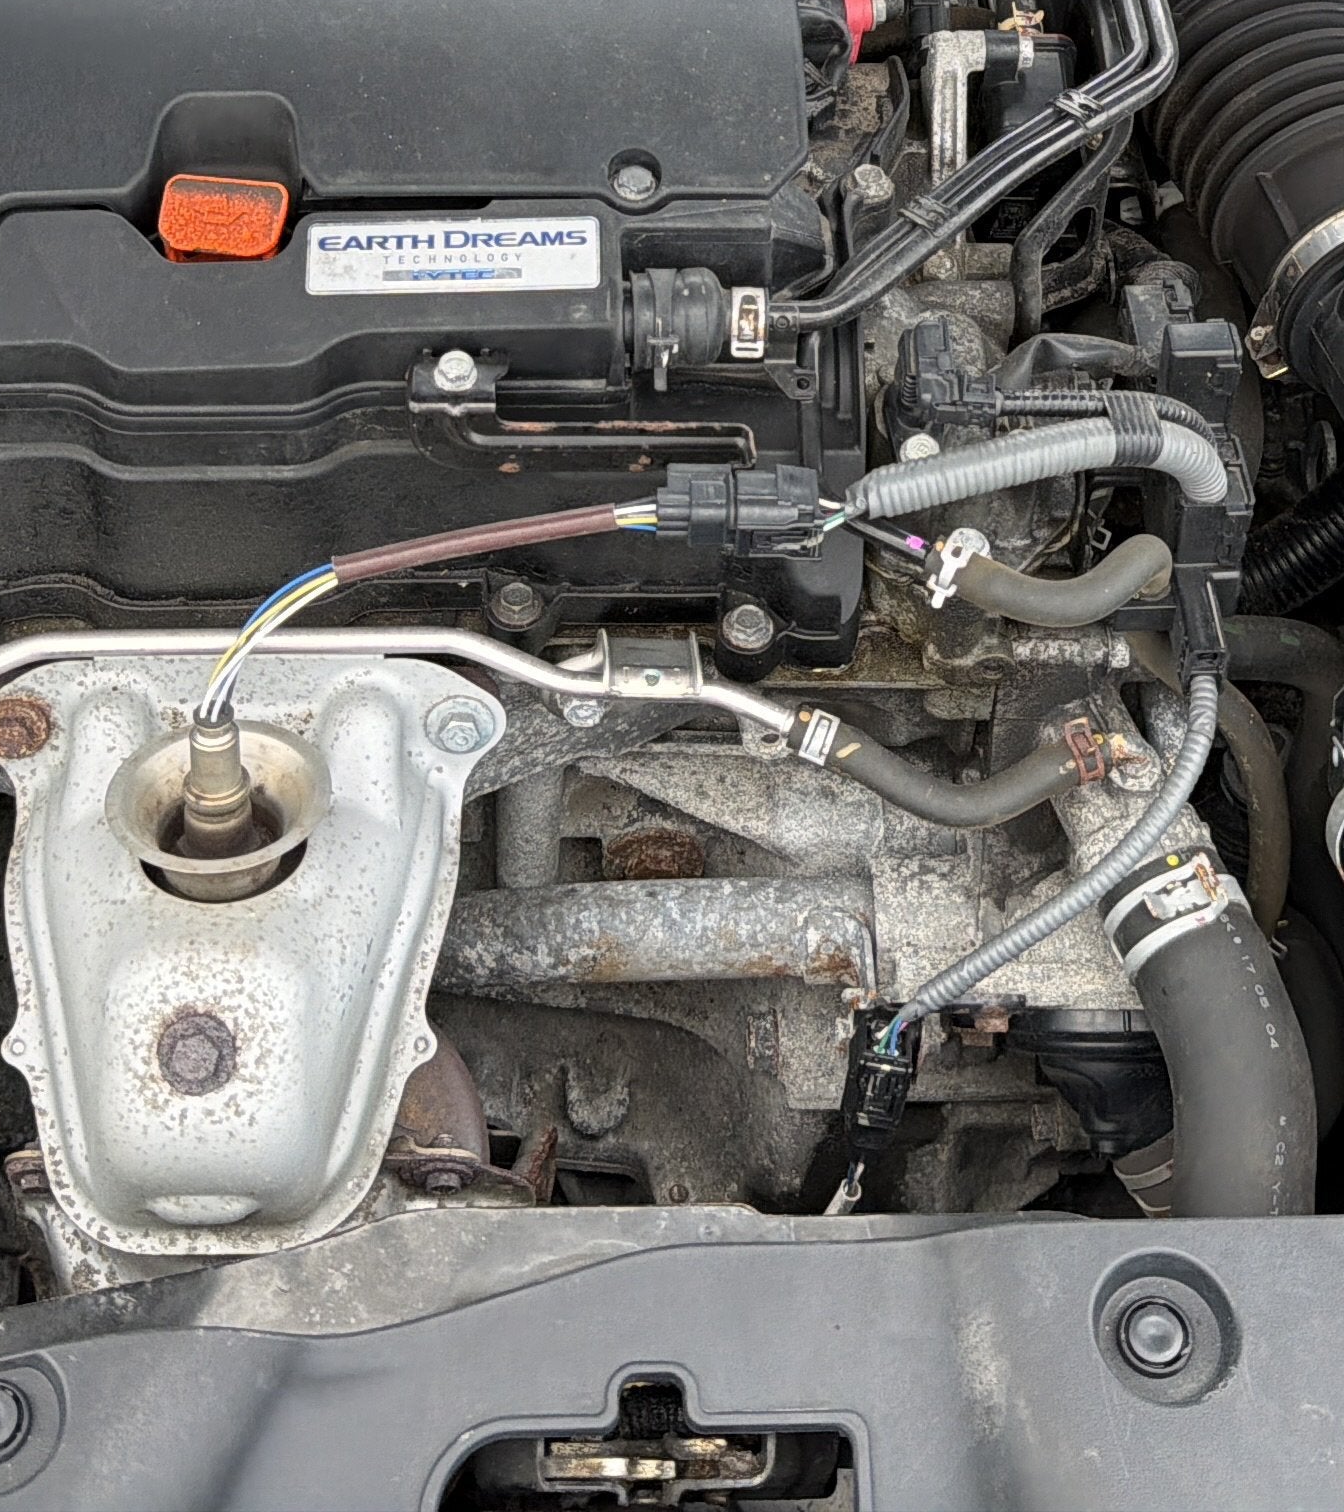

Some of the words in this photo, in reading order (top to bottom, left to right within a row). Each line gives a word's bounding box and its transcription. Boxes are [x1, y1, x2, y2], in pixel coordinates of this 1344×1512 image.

[318, 234, 435, 251] EARTH
[443, 230, 588, 249] DREAMS
[383, 252, 523, 265] TECHNOLOGY
[1265, 1023, 1280, 1049] 04
